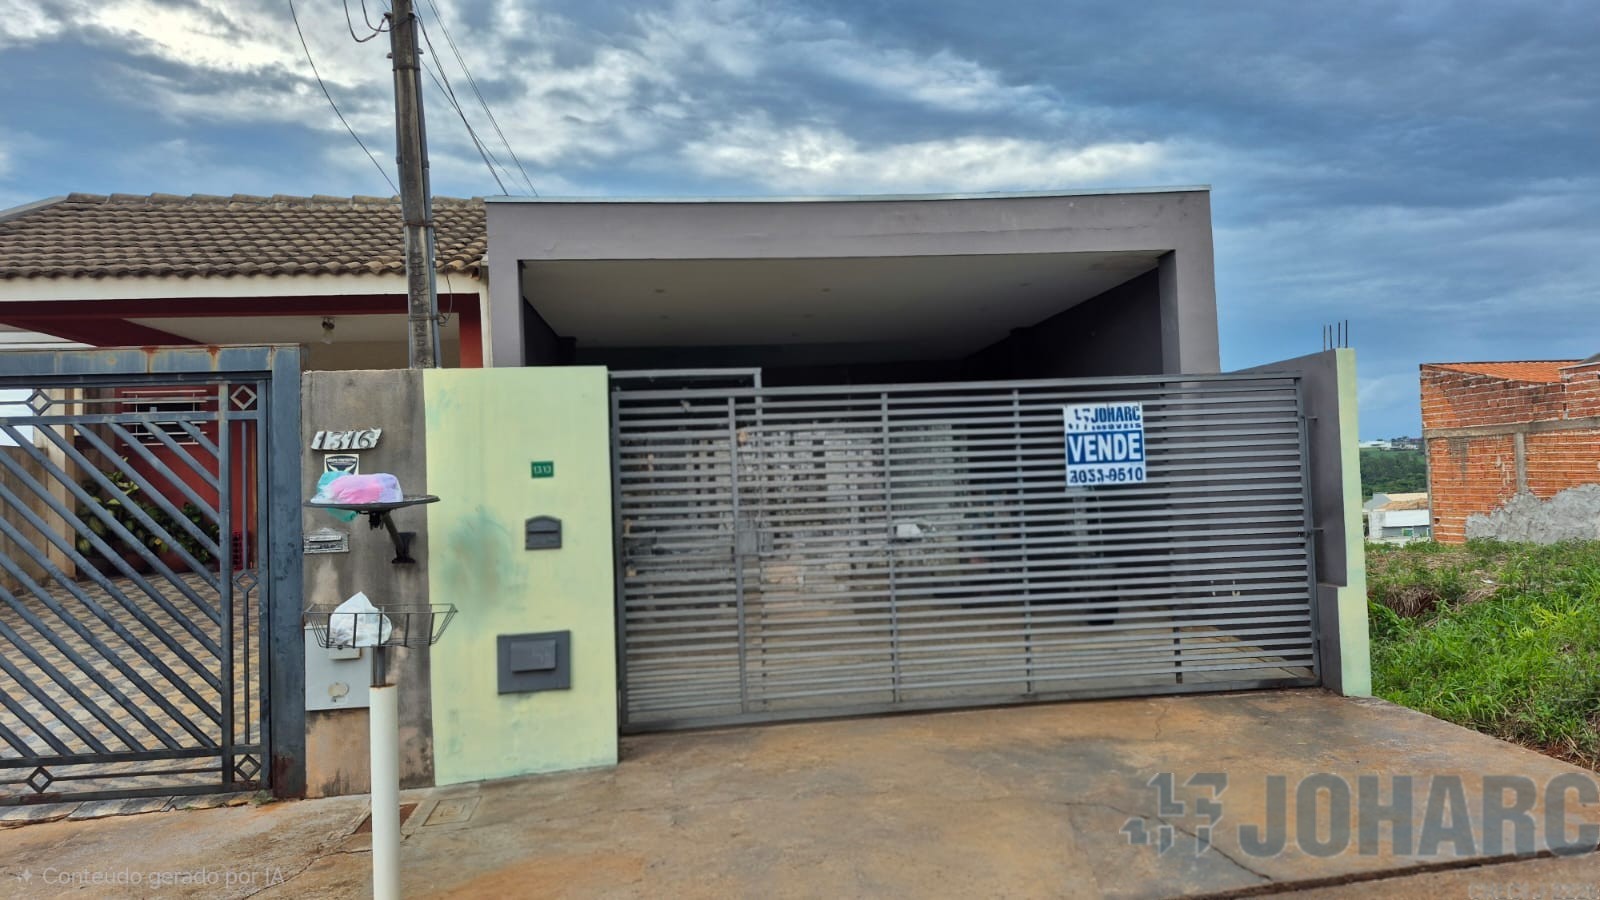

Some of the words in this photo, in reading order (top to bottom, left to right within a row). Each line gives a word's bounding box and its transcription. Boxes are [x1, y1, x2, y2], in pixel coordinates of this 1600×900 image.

[1091, 405, 1141, 423] JOHARC
[314, 430, 378, 449] 1316
[1068, 433, 1142, 463] VENDE
